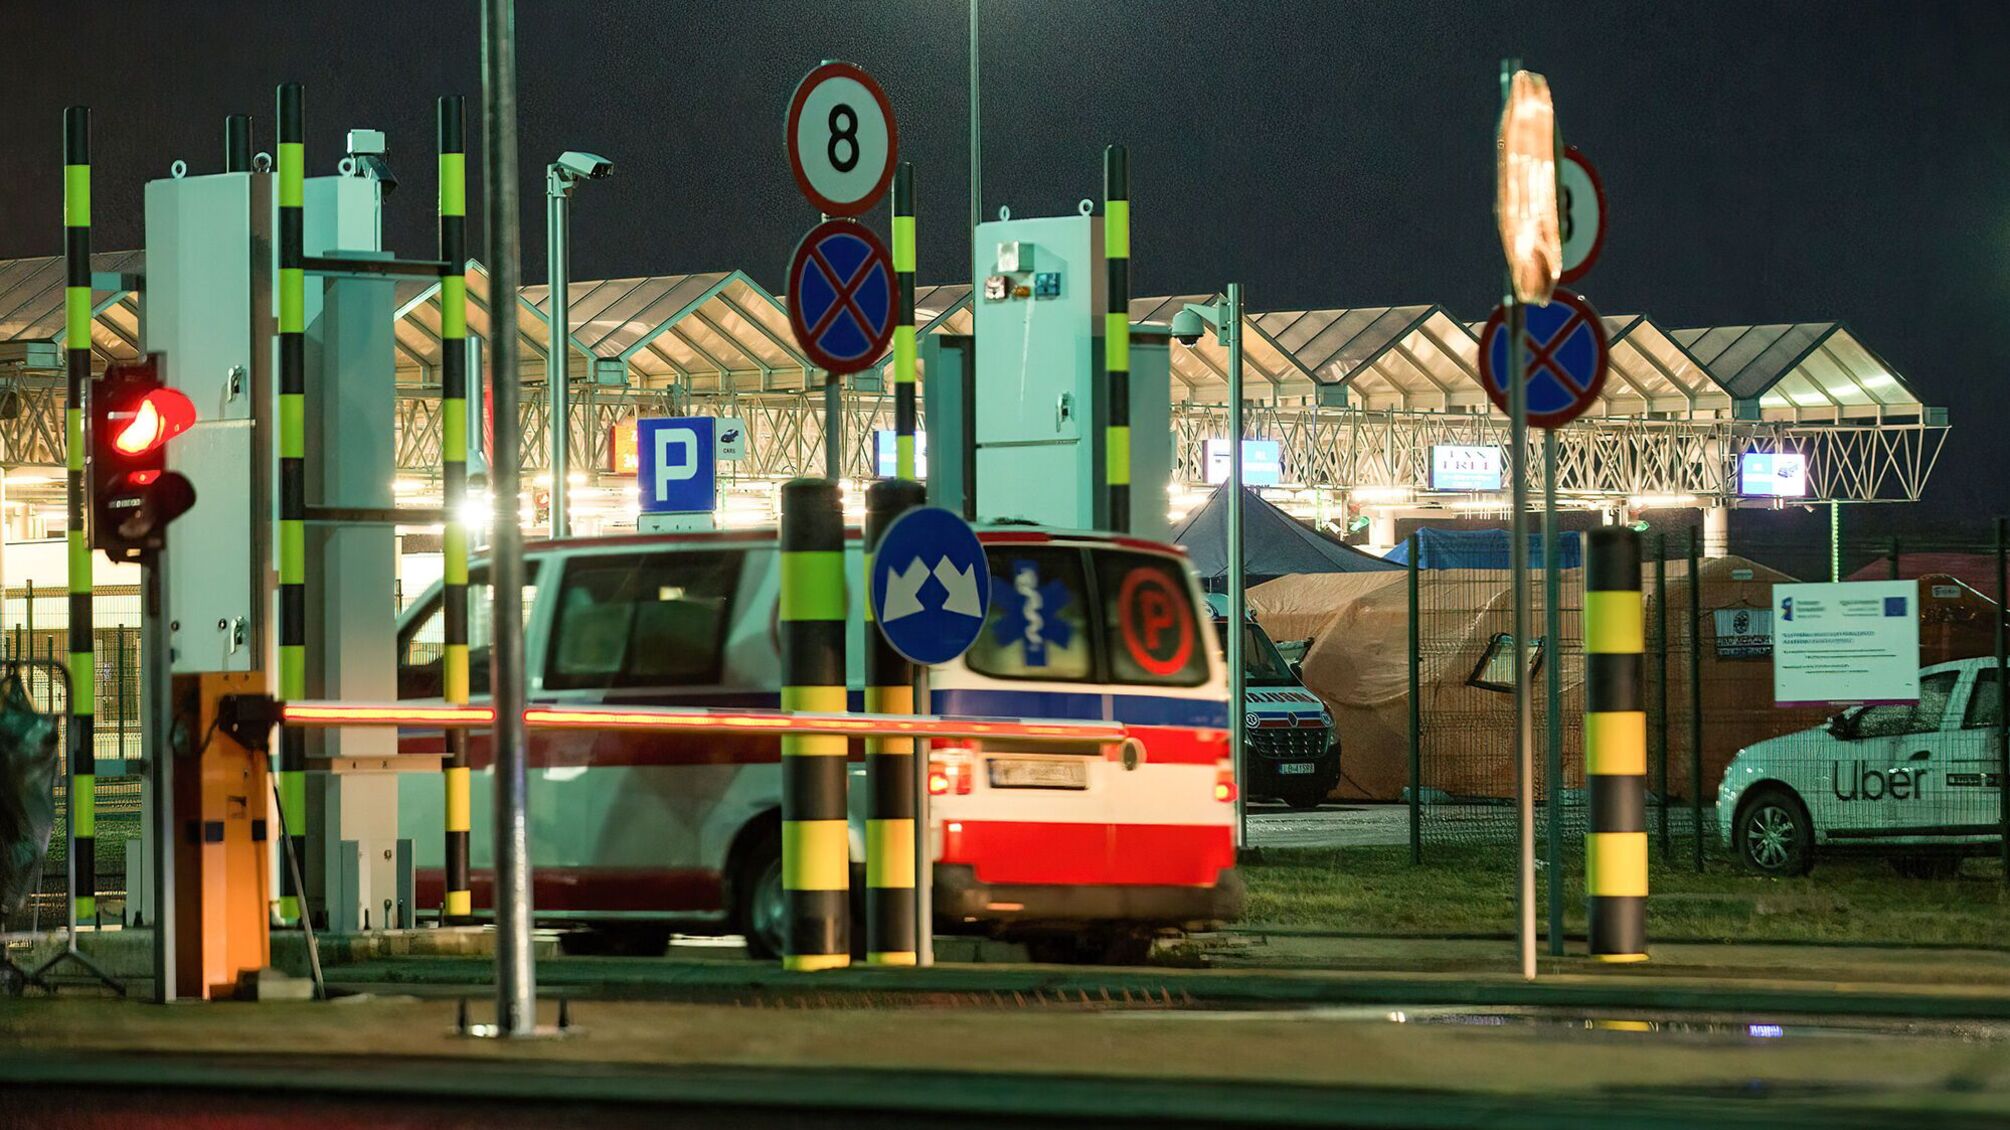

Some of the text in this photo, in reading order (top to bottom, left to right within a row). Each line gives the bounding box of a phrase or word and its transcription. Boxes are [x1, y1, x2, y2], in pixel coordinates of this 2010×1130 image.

[828, 103, 860, 173] 8
[655, 428, 698, 501] P
[1140, 590, 1174, 650] P
[1834, 760, 1928, 801] Uber
